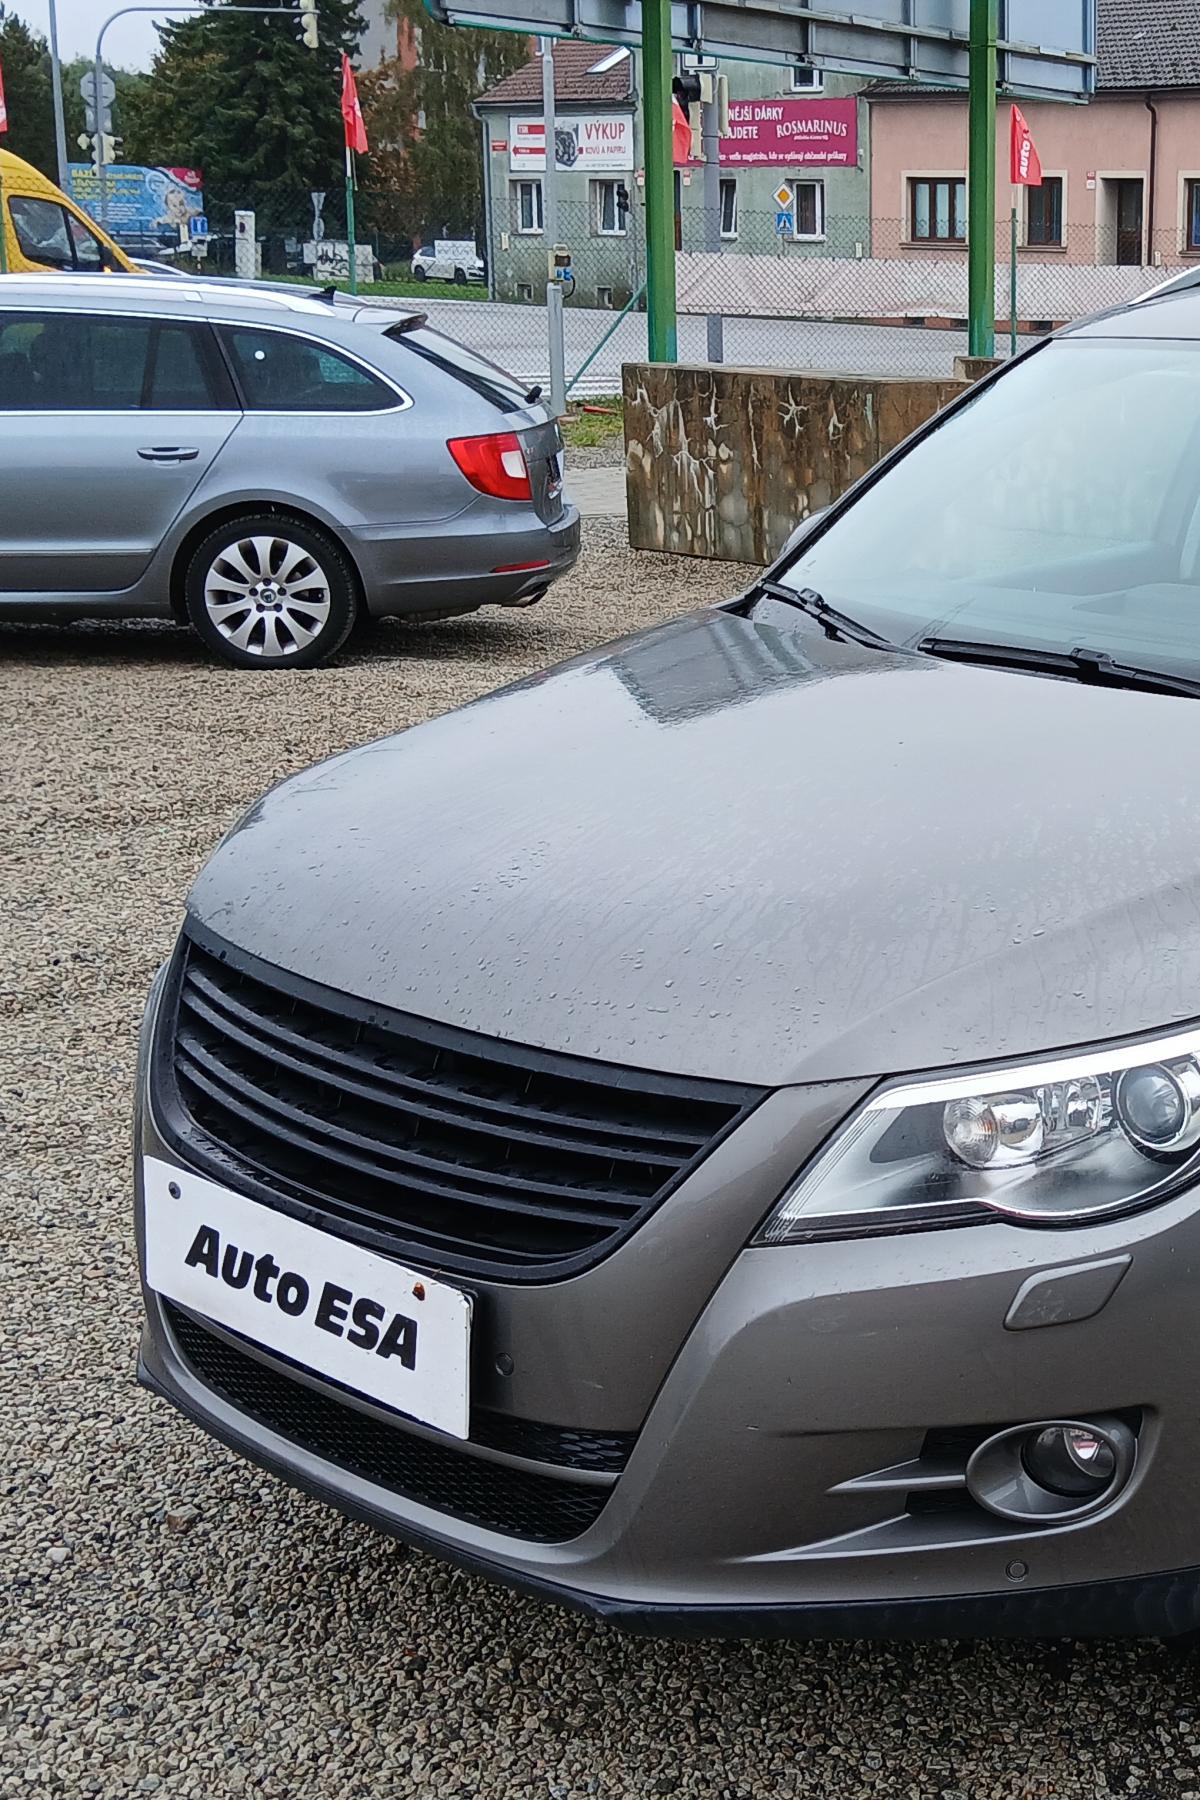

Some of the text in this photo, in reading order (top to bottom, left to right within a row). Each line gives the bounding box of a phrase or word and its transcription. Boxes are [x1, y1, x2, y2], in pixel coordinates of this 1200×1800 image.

[729, 105, 783, 121] NĚJŠÍ DÁRKY
[585, 119, 625, 140] VÝKUP
[776, 119, 847, 138] ROSMARINUS
[184, 1224, 418, 1371] Auto ESA
